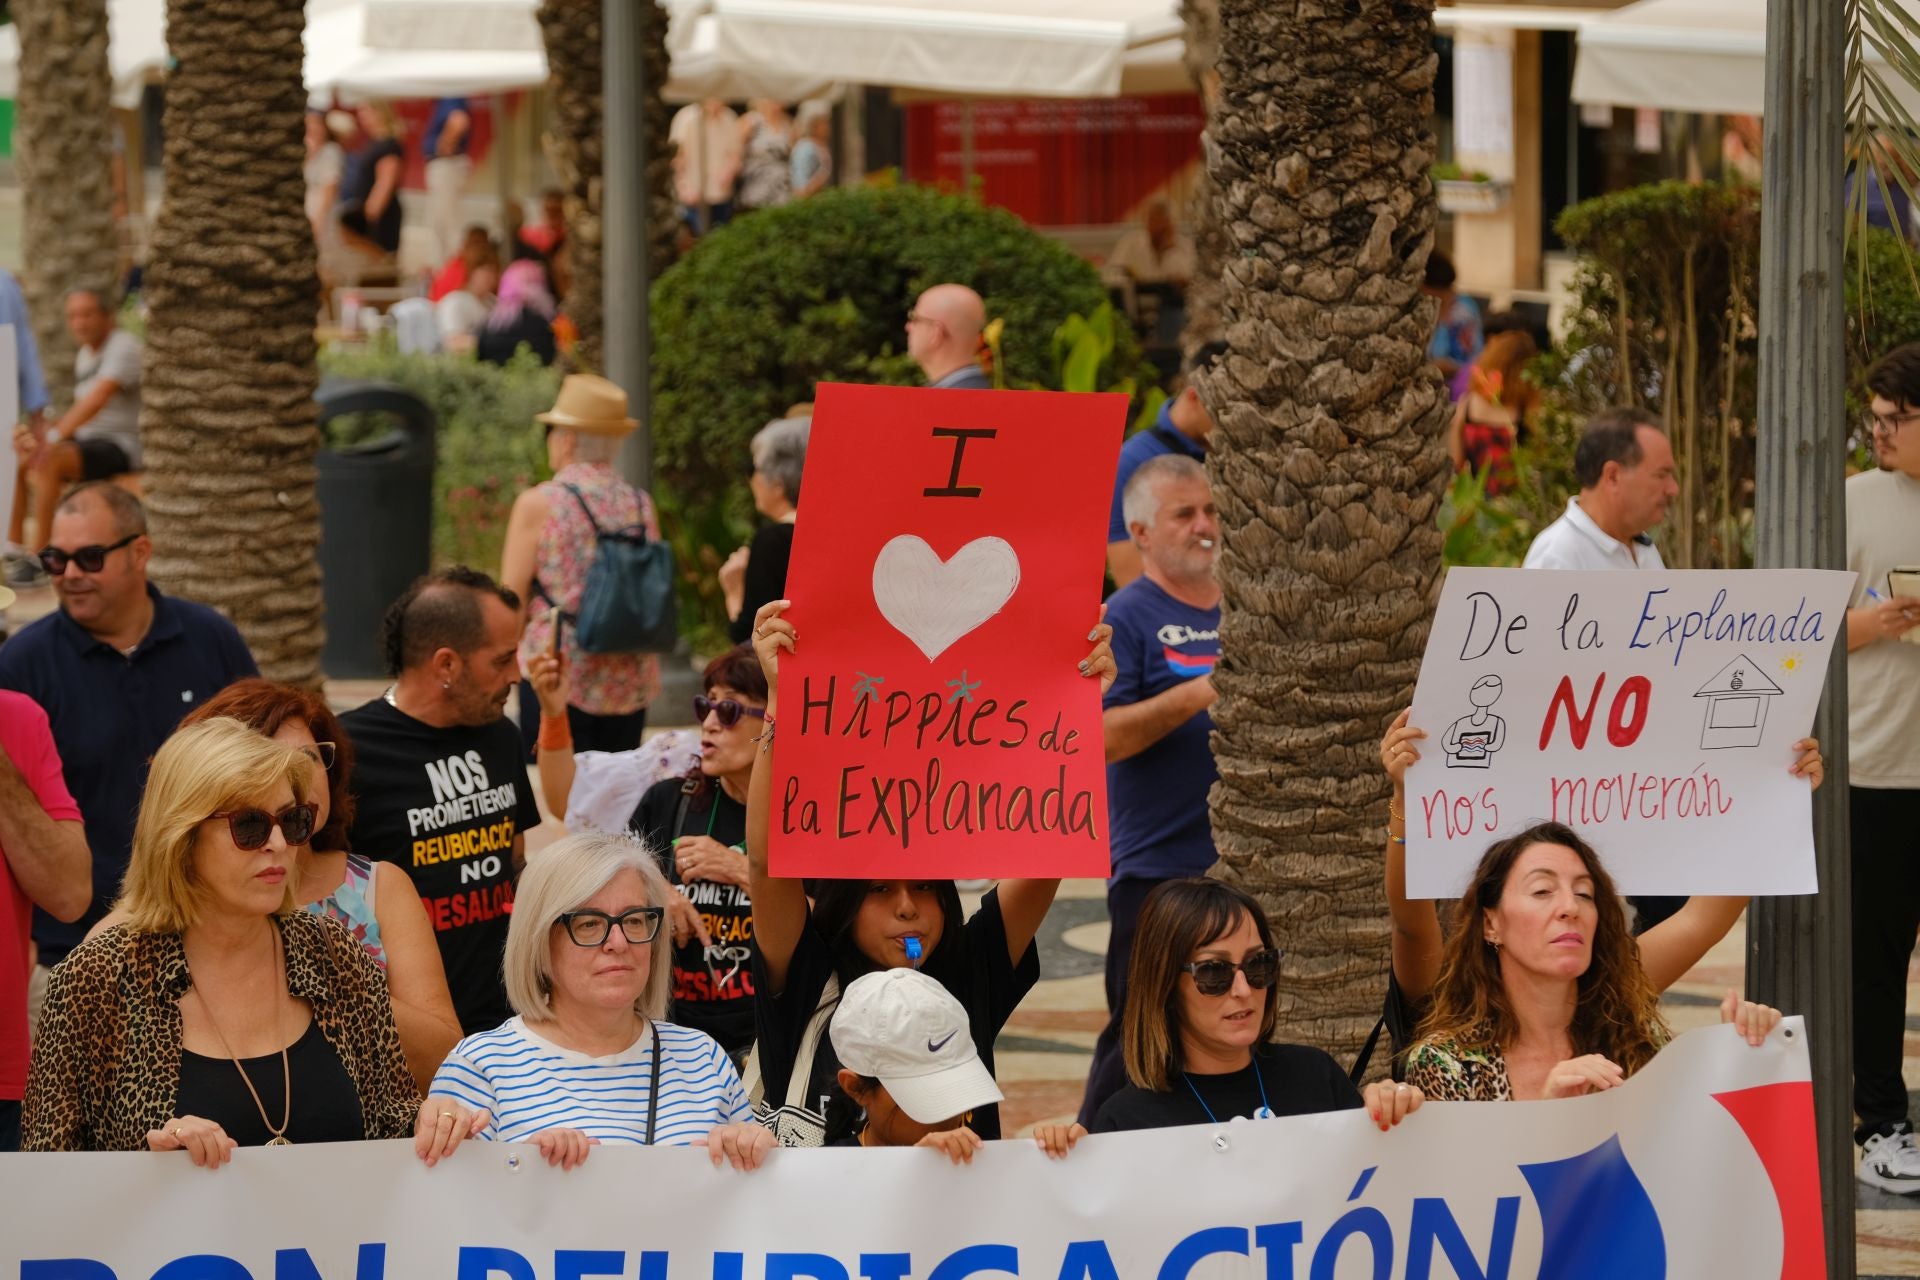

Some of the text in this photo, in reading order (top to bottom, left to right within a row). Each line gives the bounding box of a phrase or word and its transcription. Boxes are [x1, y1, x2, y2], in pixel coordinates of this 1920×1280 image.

[923, 427, 997, 498] I
[1460, 588, 1825, 666] De la Explanada
[800, 671, 1080, 755] Hippies de
[1538, 672, 1652, 751] NO
[406, 782, 518, 837] PROMETIERON
[424, 749, 490, 803] NOS
[782, 757, 1099, 849] la Explanada
[1422, 762, 1733, 840] nos moverán
[460, 855, 502, 884] NO
